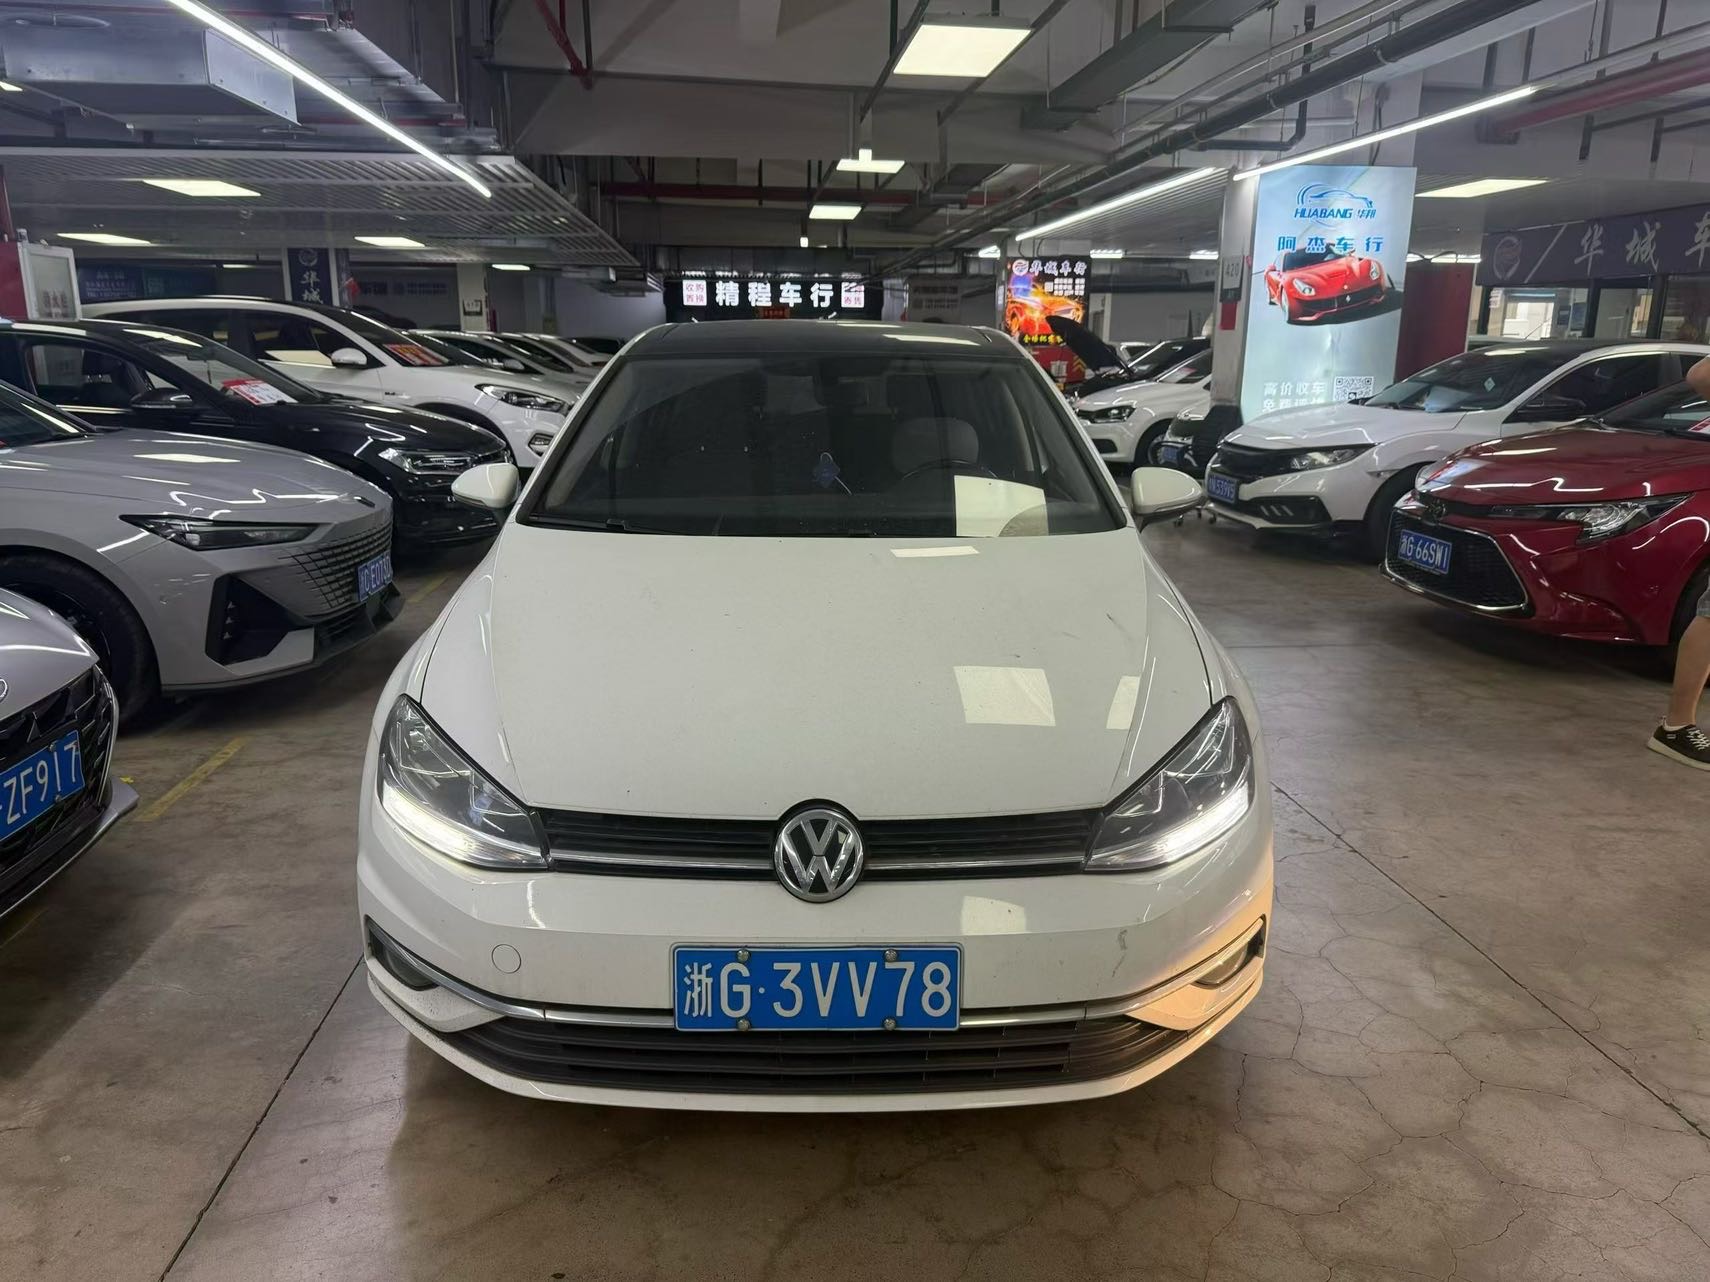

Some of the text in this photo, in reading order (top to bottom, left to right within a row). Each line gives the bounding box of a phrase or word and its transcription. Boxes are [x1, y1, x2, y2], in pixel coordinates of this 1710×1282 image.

[1294, 208, 1353, 218] HUABANG
[1278, 236, 1384, 252] 阿杰车行
[715, 281, 834, 307] 精程车行
[1264, 382, 1326, 396] 高价收车
[683, 961, 952, 1018] 浙G·3VV78
